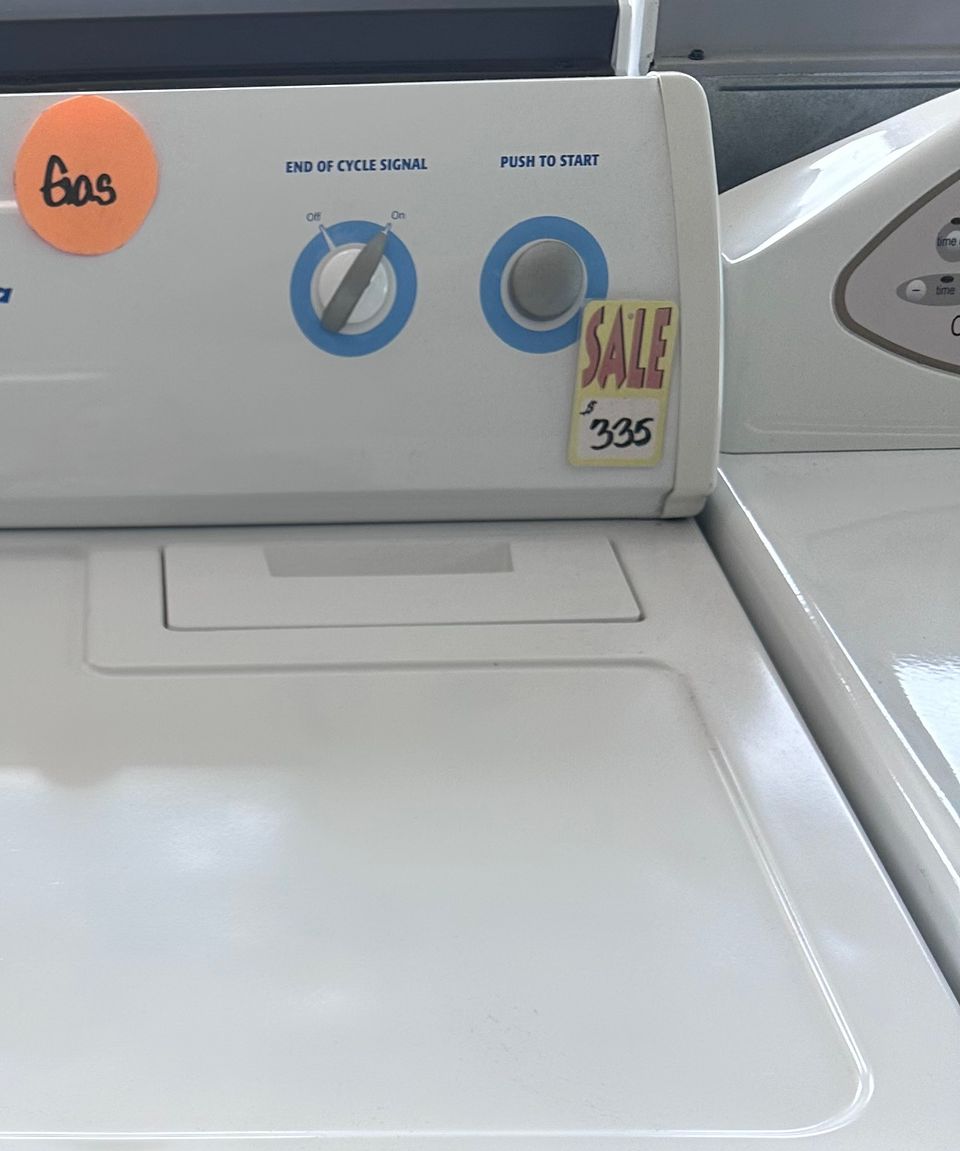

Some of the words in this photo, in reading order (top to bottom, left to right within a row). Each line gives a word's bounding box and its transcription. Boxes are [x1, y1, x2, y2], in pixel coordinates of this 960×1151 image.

[285, 161, 313, 173] END
[317, 160, 334, 172] OF
[337, 159, 376, 172] CYCLE
[380, 158, 428, 171] SIGNAL
[500, 155, 535, 168] PUSH
[539, 155, 556, 167] TO
[560, 154, 600, 167] START
[40, 155, 117, 207] Gas
[306, 211, 321, 222] Off
[391, 210, 405, 220] On
[581, 304, 673, 390] SALE
